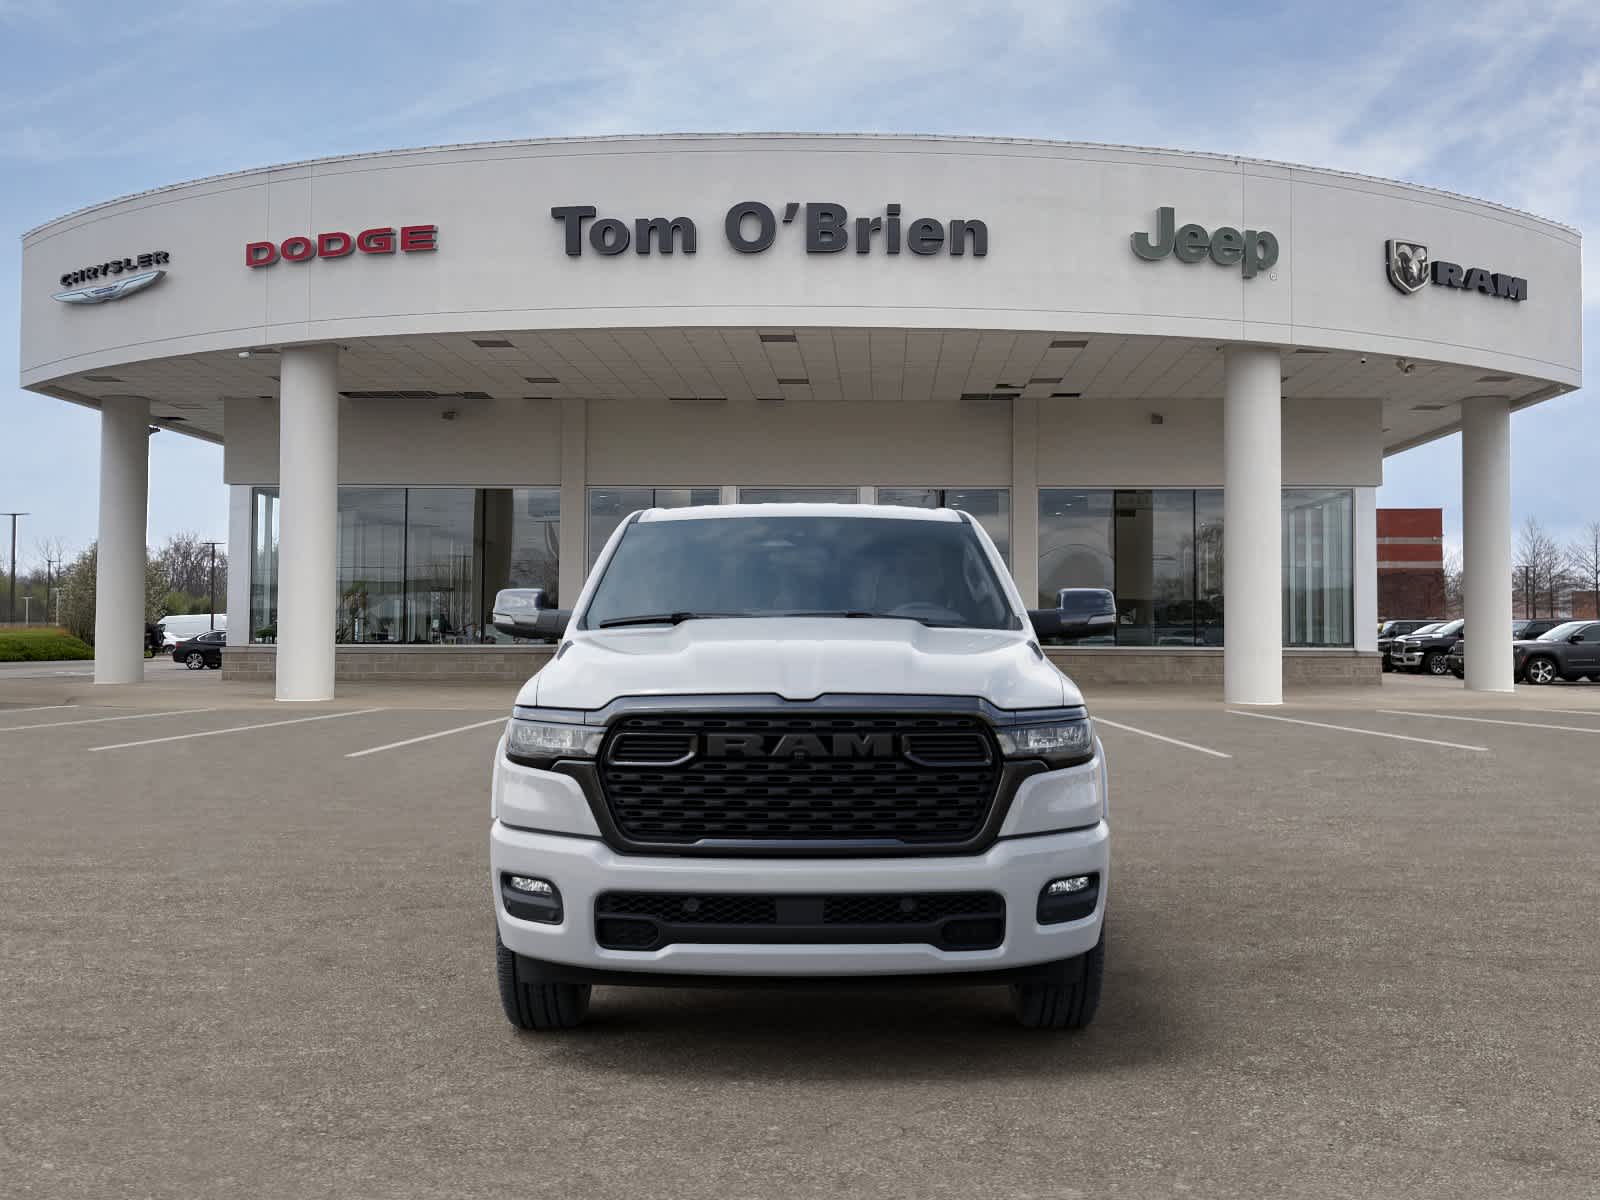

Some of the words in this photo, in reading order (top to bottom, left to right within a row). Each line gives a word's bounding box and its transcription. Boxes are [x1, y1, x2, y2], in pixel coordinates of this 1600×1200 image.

[245, 224, 438, 269] DODGE
[551, 205, 697, 257] Tom
[725, 201, 988, 257] O'Brien
[1130, 207, 1280, 279] Jeep
[60, 250, 170, 287] CHRYSLER
[1430, 260, 1528, 301] RAM
[706, 733, 893, 757] RAM
